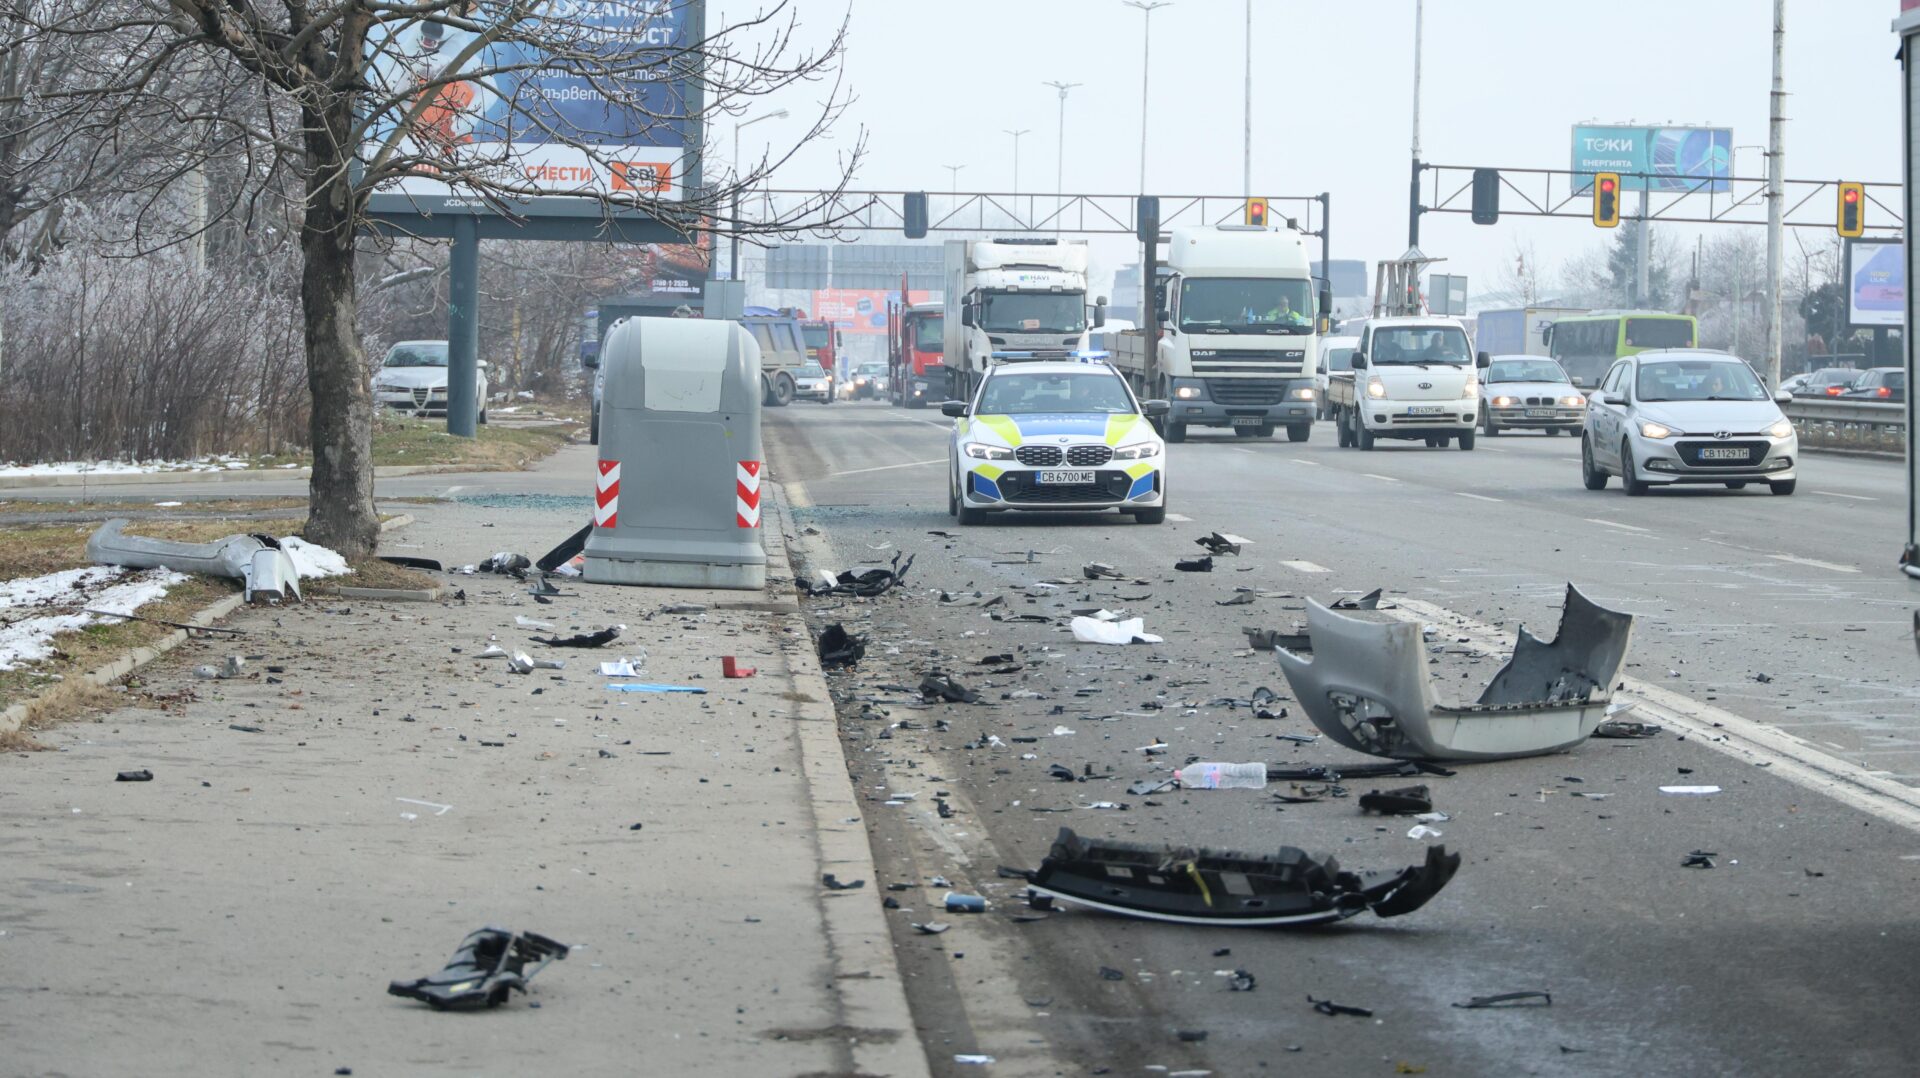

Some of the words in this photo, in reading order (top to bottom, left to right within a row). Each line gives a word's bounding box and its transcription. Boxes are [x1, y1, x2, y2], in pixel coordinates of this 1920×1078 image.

[1583, 138, 1633, 152] ТОКИ
[1582, 159, 1633, 167] ЕНЕРГИЯТА
[526, 165, 593, 182] СПЕСТИ
[1703, 449, 1715, 458] CB
[1717, 449, 1736, 458] 1129
[1737, 449, 1748, 458] TH
[1041, 472, 1054, 482] CB
[1056, 472, 1080, 482] 6700
[1080, 472, 1094, 482] ME
